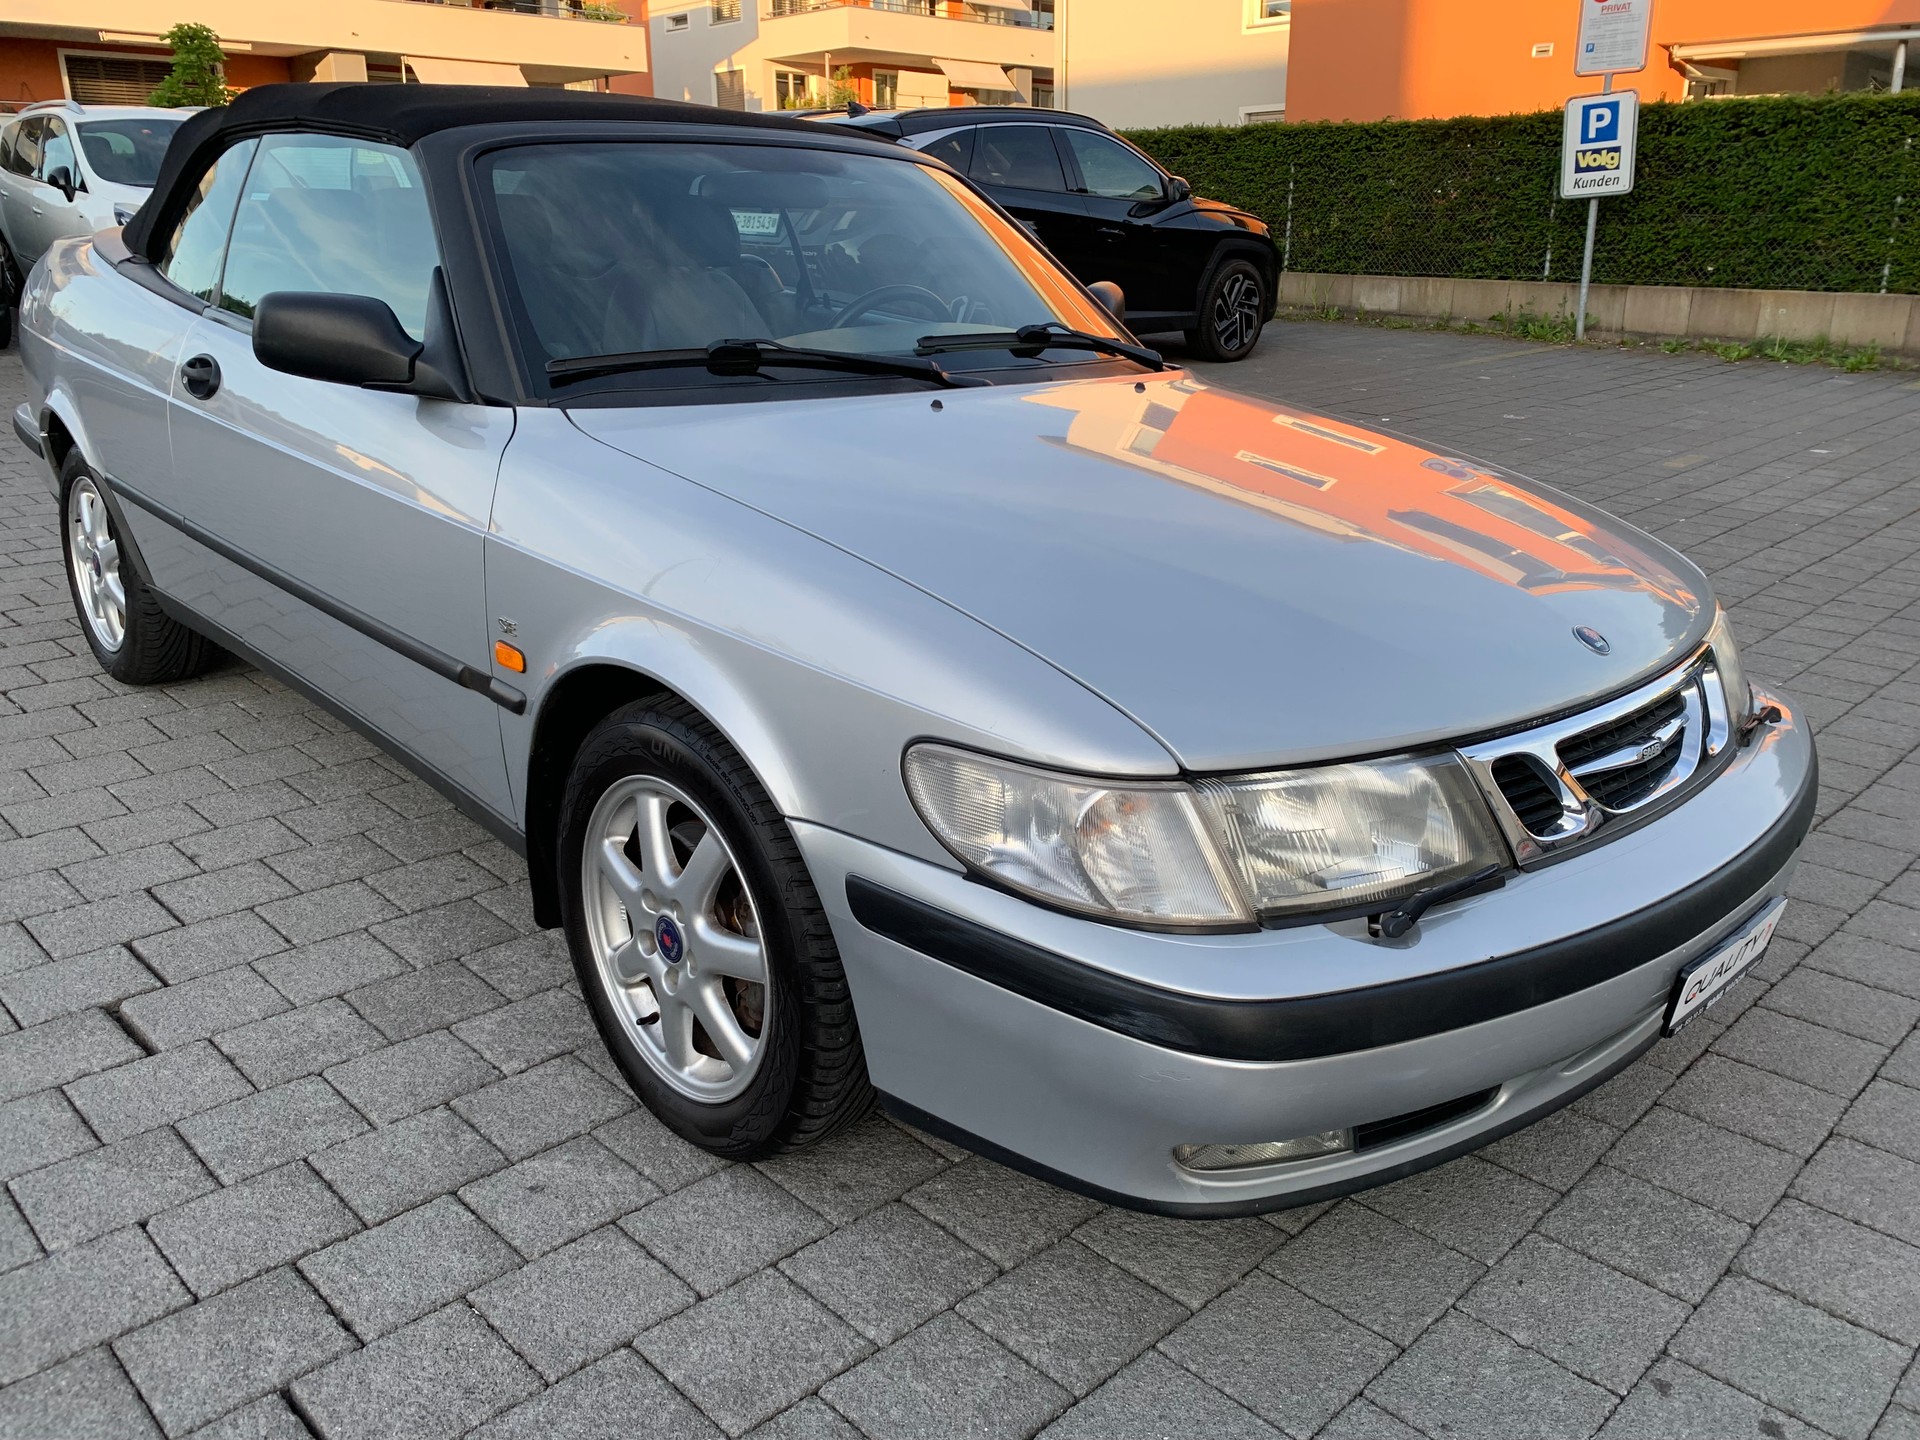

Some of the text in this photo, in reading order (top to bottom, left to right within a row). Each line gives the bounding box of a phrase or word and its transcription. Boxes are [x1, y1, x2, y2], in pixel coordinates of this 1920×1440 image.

[1601, 2, 1632, 13] PRIVAT
[1588, 107, 1612, 139] P
[1576, 149, 1620, 170] Volg
[1573, 175, 1620, 189] Kunden
[1643, 743, 1661, 759] SAAB
[704, 754, 760, 826] SHARK SKIN TECHNOLOGY
